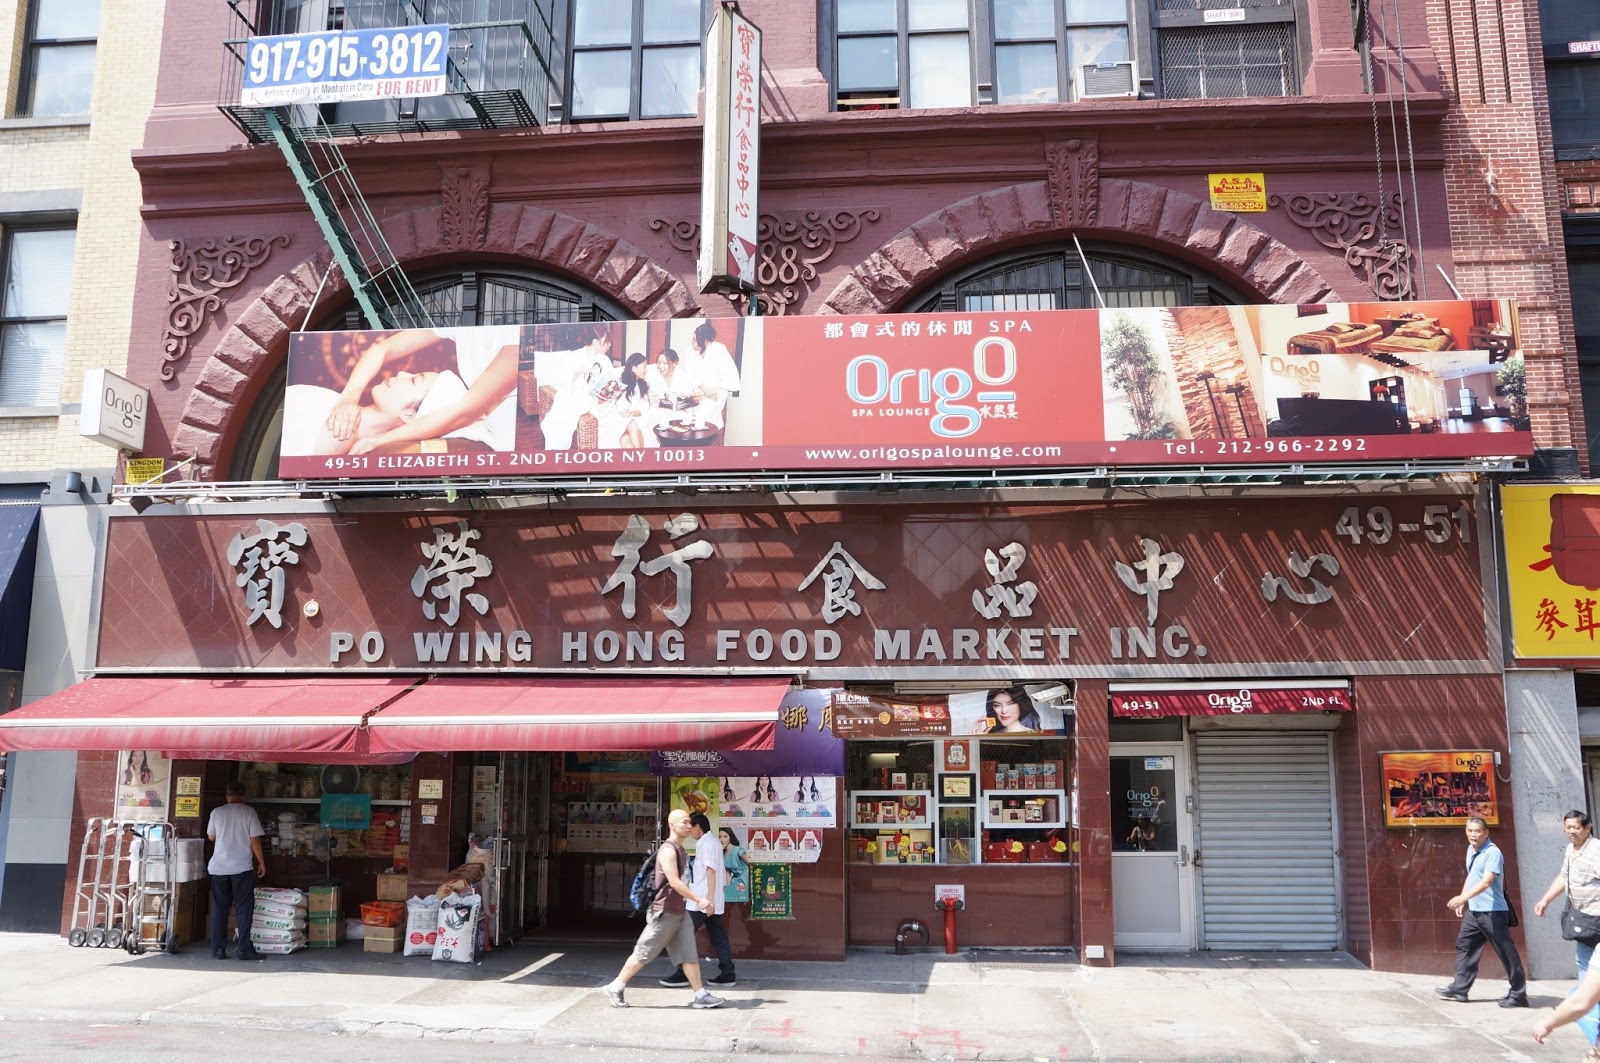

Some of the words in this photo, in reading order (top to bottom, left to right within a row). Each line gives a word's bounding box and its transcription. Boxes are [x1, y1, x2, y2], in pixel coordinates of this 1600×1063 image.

[250, 30, 442, 83] 917-915-3812
[321, 83, 356, 94] Manhattan
[376, 80, 401, 96] FOR
[405, 78, 441, 94] RENT
[989, 319, 1033, 333] SPA
[852, 409, 873, 417] SPA
[879, 407, 930, 417] LOUNGE
[805, 445, 1062, 461] www.origospalounge.com
[1164, 442, 1205, 455] Tel.
[1217, 438, 1367, 454] 212-966-2292
[324, 457, 369, 469] 49-51
[377, 454, 469, 469] ELIZABETH
[476, 454, 501, 467] ST.
[509, 453, 547, 465] 2ND
[555, 451, 614, 465] FLOOR
[622, 450, 646, 463] NY
[654, 448, 706, 462] 10013
[1335, 504, 1472, 545] 49-51
[329, 631, 385, 663] PO
[413, 630, 533, 663] WING
[562, 629, 686, 662] HONG
[716, 628, 842, 661] FOOD
[874, 626, 1078, 661] MARKET
[1110, 625, 1208, 659] INC.
[1121, 700, 1160, 711] 49-51
[1302, 697, 1325, 707] 2ND
[1329, 695, 1344, 706] FL.
